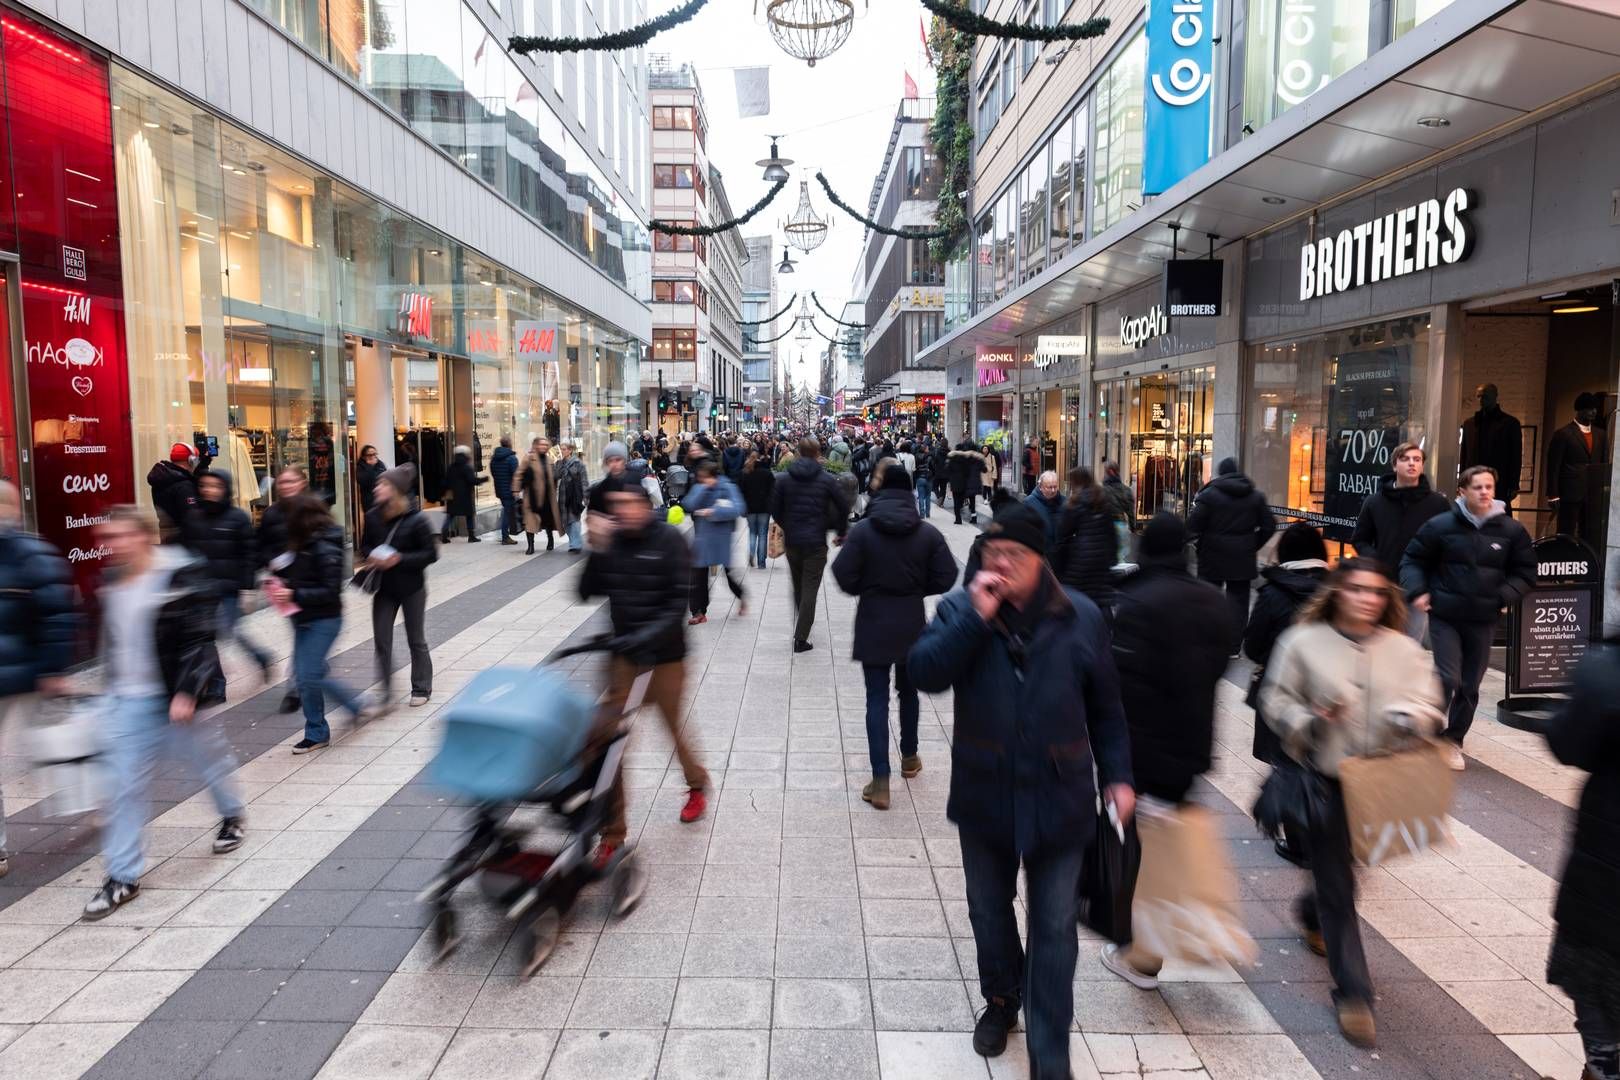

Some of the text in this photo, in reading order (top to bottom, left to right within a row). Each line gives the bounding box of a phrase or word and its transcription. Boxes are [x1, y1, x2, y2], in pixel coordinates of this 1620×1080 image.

[1300, 187, 1468, 301] BROTHERS
[65, 249, 82, 260] HALL
[66, 257, 83, 268] BERG
[66, 267, 84, 278] GULD
[64, 294, 91, 326] H&M
[1171, 304, 1216, 315] BROTHERS
[519, 328, 555, 354] H&M
[64, 444, 107, 454] Dressmann
[1341, 429, 1389, 465] 70%
[1339, 472, 1381, 496] RABAT
[1534, 607, 1577, 623] 25%
[1530, 624, 1581, 634] rabatt på ALLA
